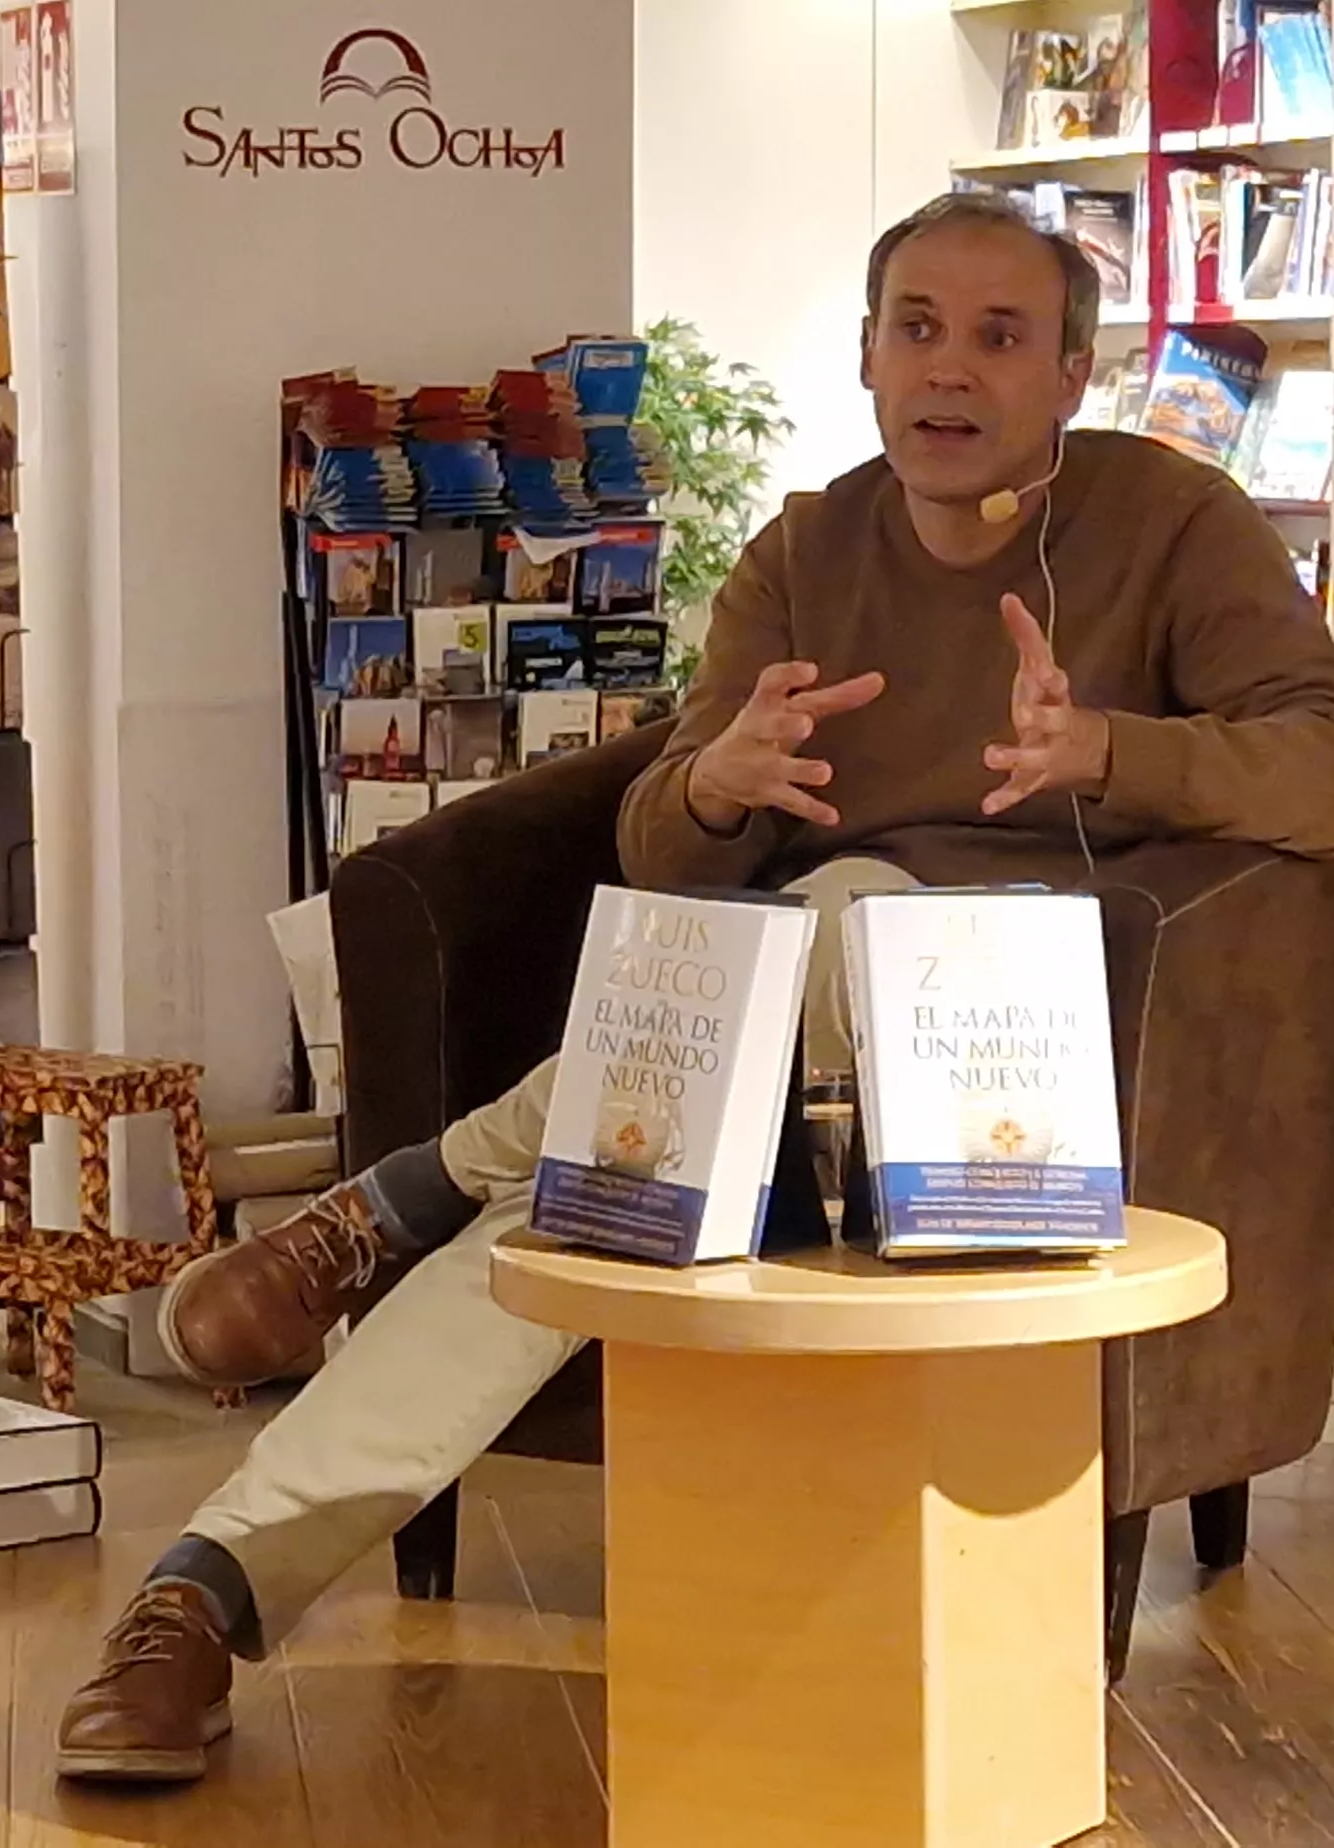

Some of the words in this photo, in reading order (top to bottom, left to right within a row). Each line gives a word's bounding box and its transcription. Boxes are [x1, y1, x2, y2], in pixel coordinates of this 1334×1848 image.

[606, 951, 727, 1001] ZUECO
[595, 998, 615, 1024] EL
[619, 1001, 682, 1038] MAPA
[690, 1013, 724, 1044] DE
[913, 1005, 942, 1030] EL
[952, 1005, 1035, 1030] MAPA
[585, 1027, 620, 1056] UN
[622, 1036, 719, 1076] MUNDO
[913, 1035, 959, 1060] UN
[969, 1036, 1090, 1060] MUN
[601, 1062, 686, 1101] NUEVO
[949, 1067, 1058, 1091] NUEVO
